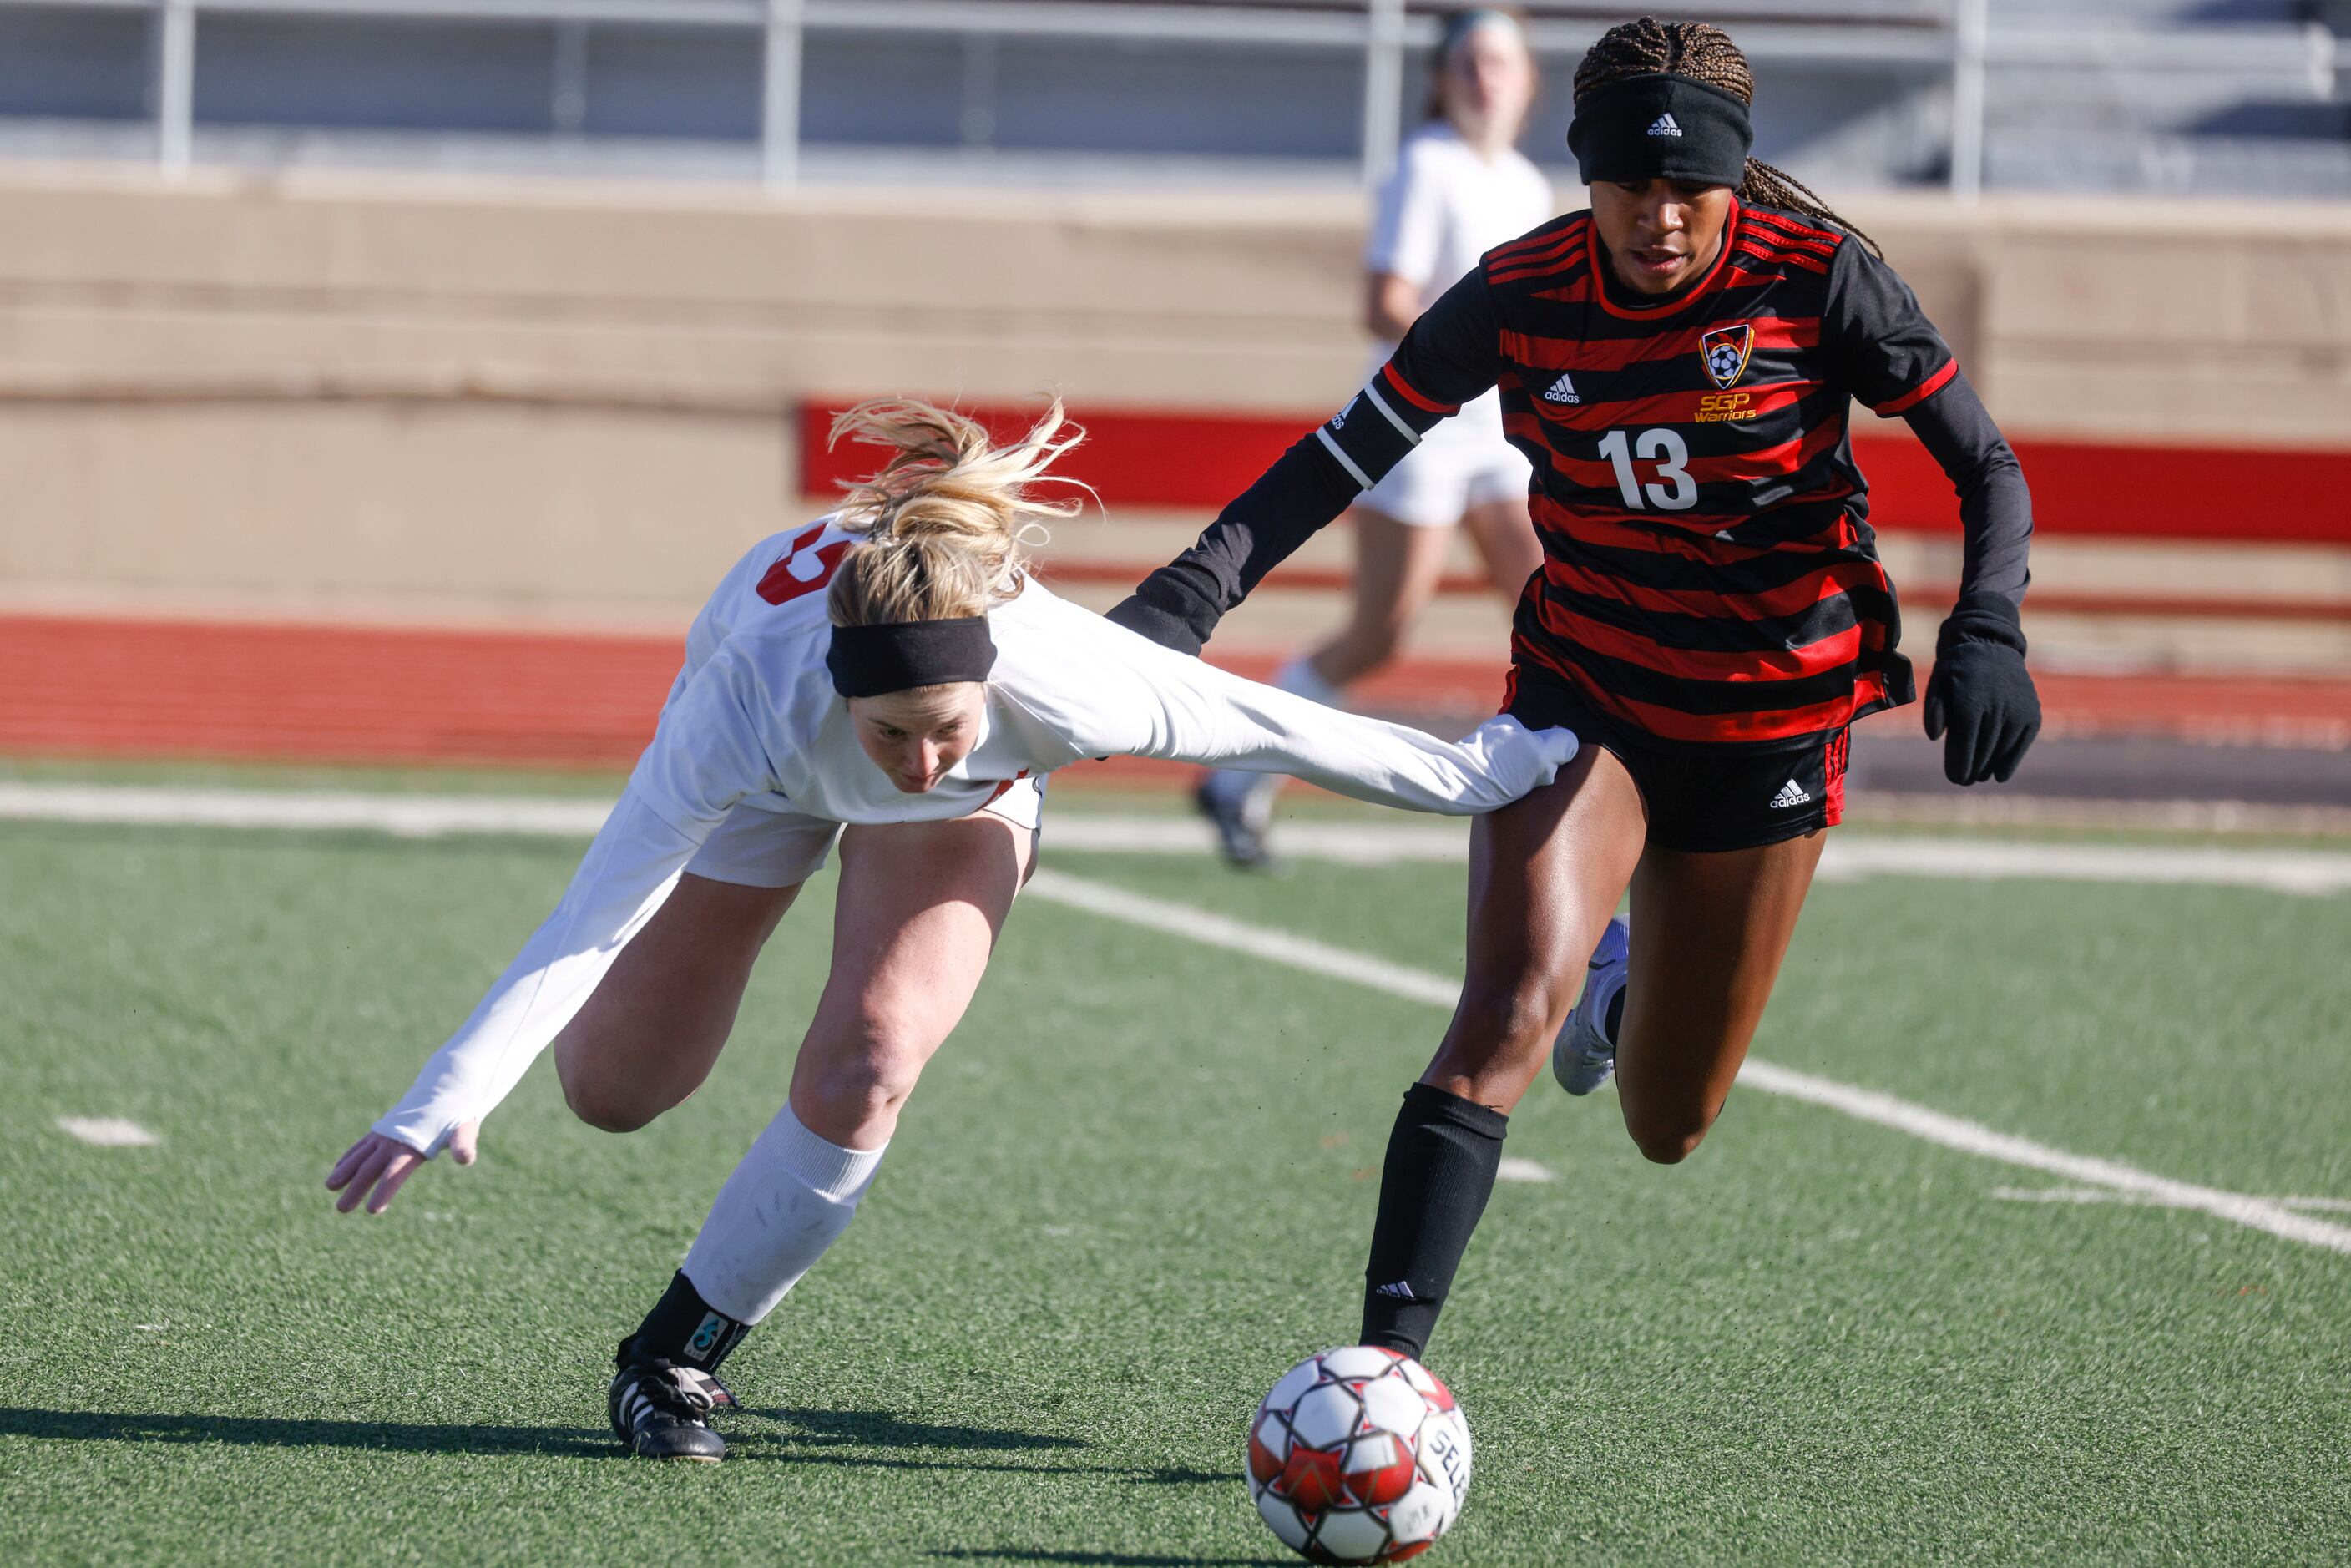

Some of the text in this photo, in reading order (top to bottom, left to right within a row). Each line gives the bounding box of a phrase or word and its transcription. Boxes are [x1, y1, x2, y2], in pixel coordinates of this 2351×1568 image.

[1647, 125, 1683, 137] adidas
[1545, 390, 1580, 404] adidas
[1700, 393, 1751, 412] SGP
[1694, 409, 1757, 423] Warriors
[1597, 427, 1698, 510] 13
[1769, 792, 1811, 808] adidas
